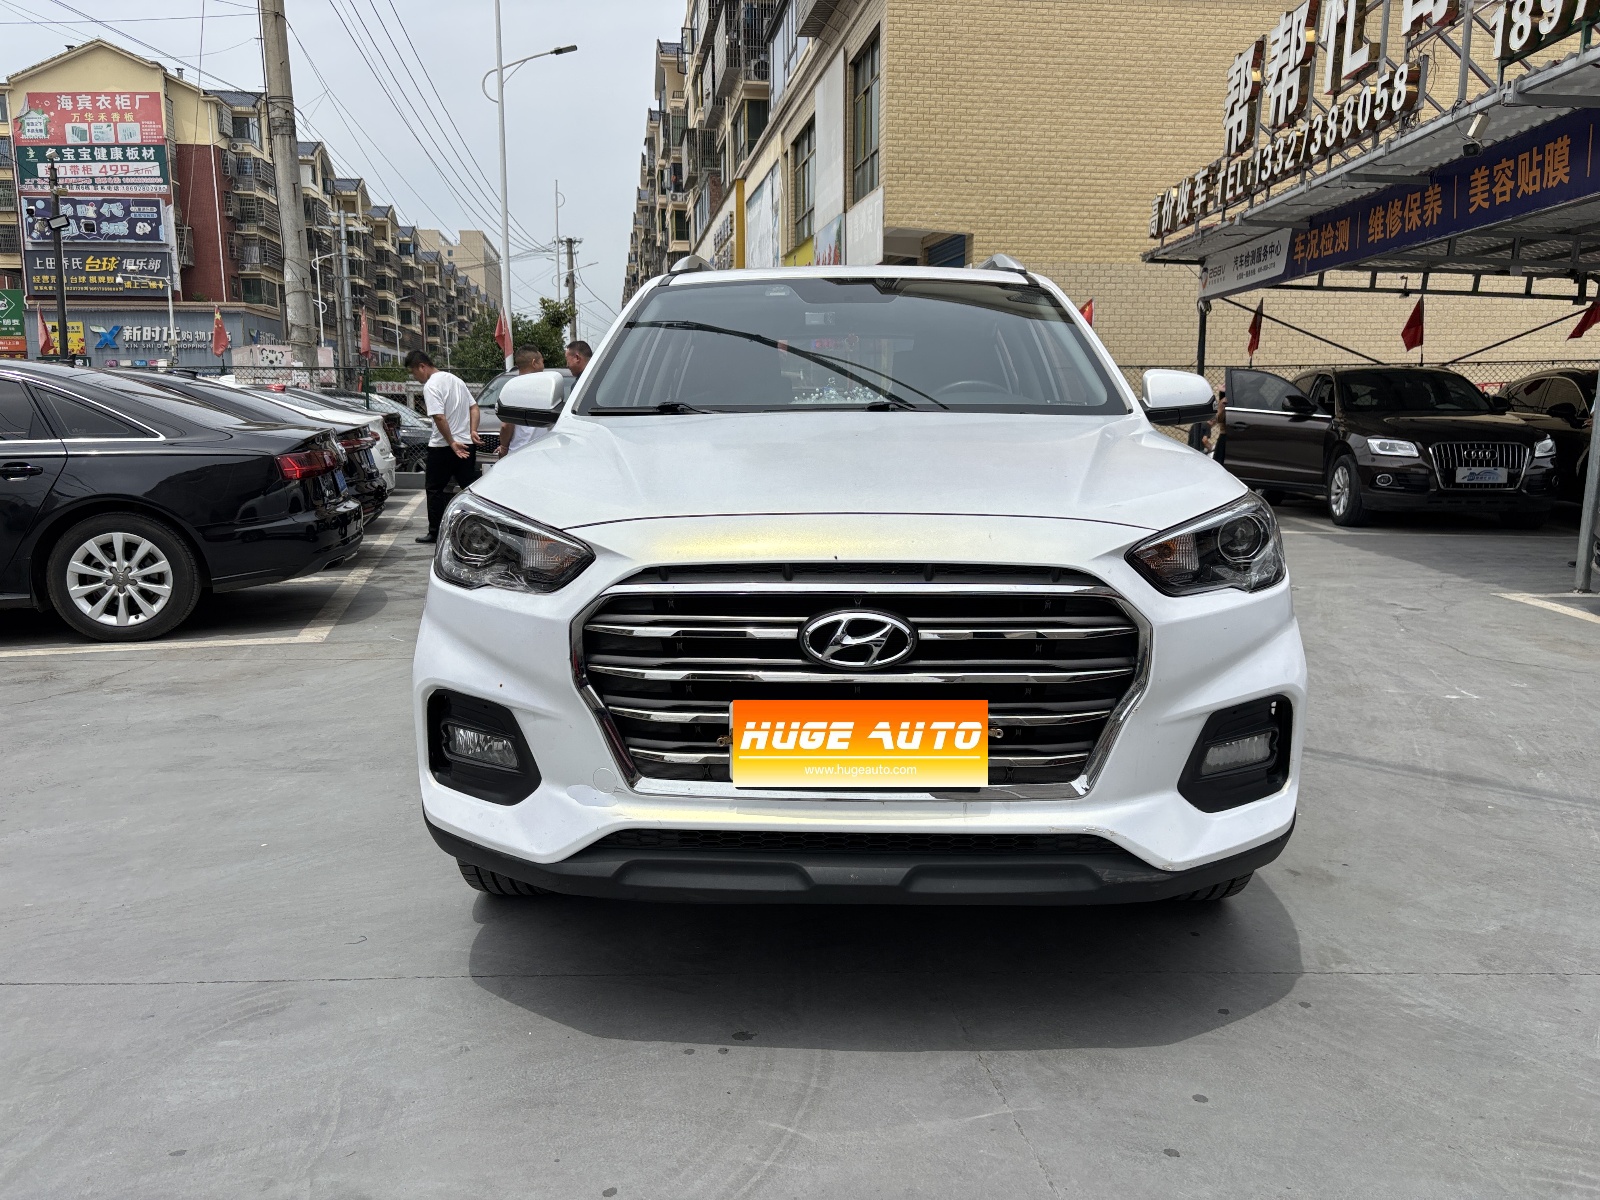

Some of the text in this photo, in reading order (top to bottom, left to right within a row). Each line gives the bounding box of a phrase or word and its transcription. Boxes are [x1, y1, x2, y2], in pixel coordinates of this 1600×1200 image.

[56, 94, 150, 110] 海宾衣柜厂
[71, 112, 135, 122] 万华禾香板
[1149, 63, 1408, 236] 高价收车 TEL:13327388058
[98, 164, 130, 176] 499
[1293, 135, 1571, 265] 车况检测 维修保养 美容贴膜
[1232, 240, 1282, 272] 汽车检测服务中心
